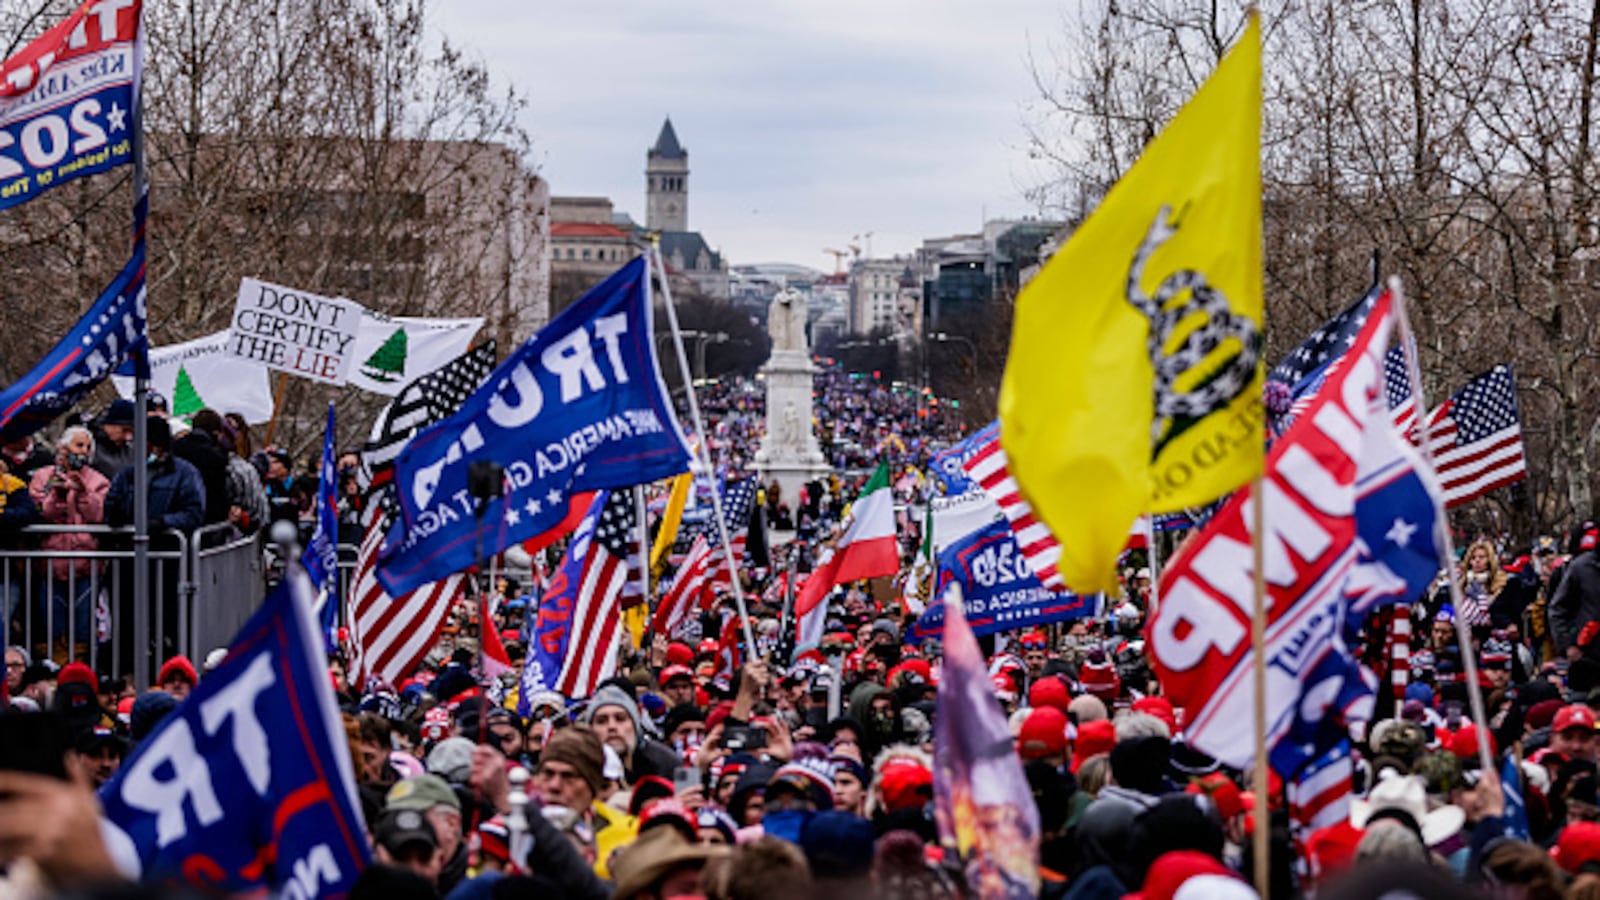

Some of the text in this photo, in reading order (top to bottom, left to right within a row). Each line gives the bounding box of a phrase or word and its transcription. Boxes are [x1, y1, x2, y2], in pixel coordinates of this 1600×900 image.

[234, 332, 342, 380] THE LIE
[237, 309, 356, 356] CERTIFY
